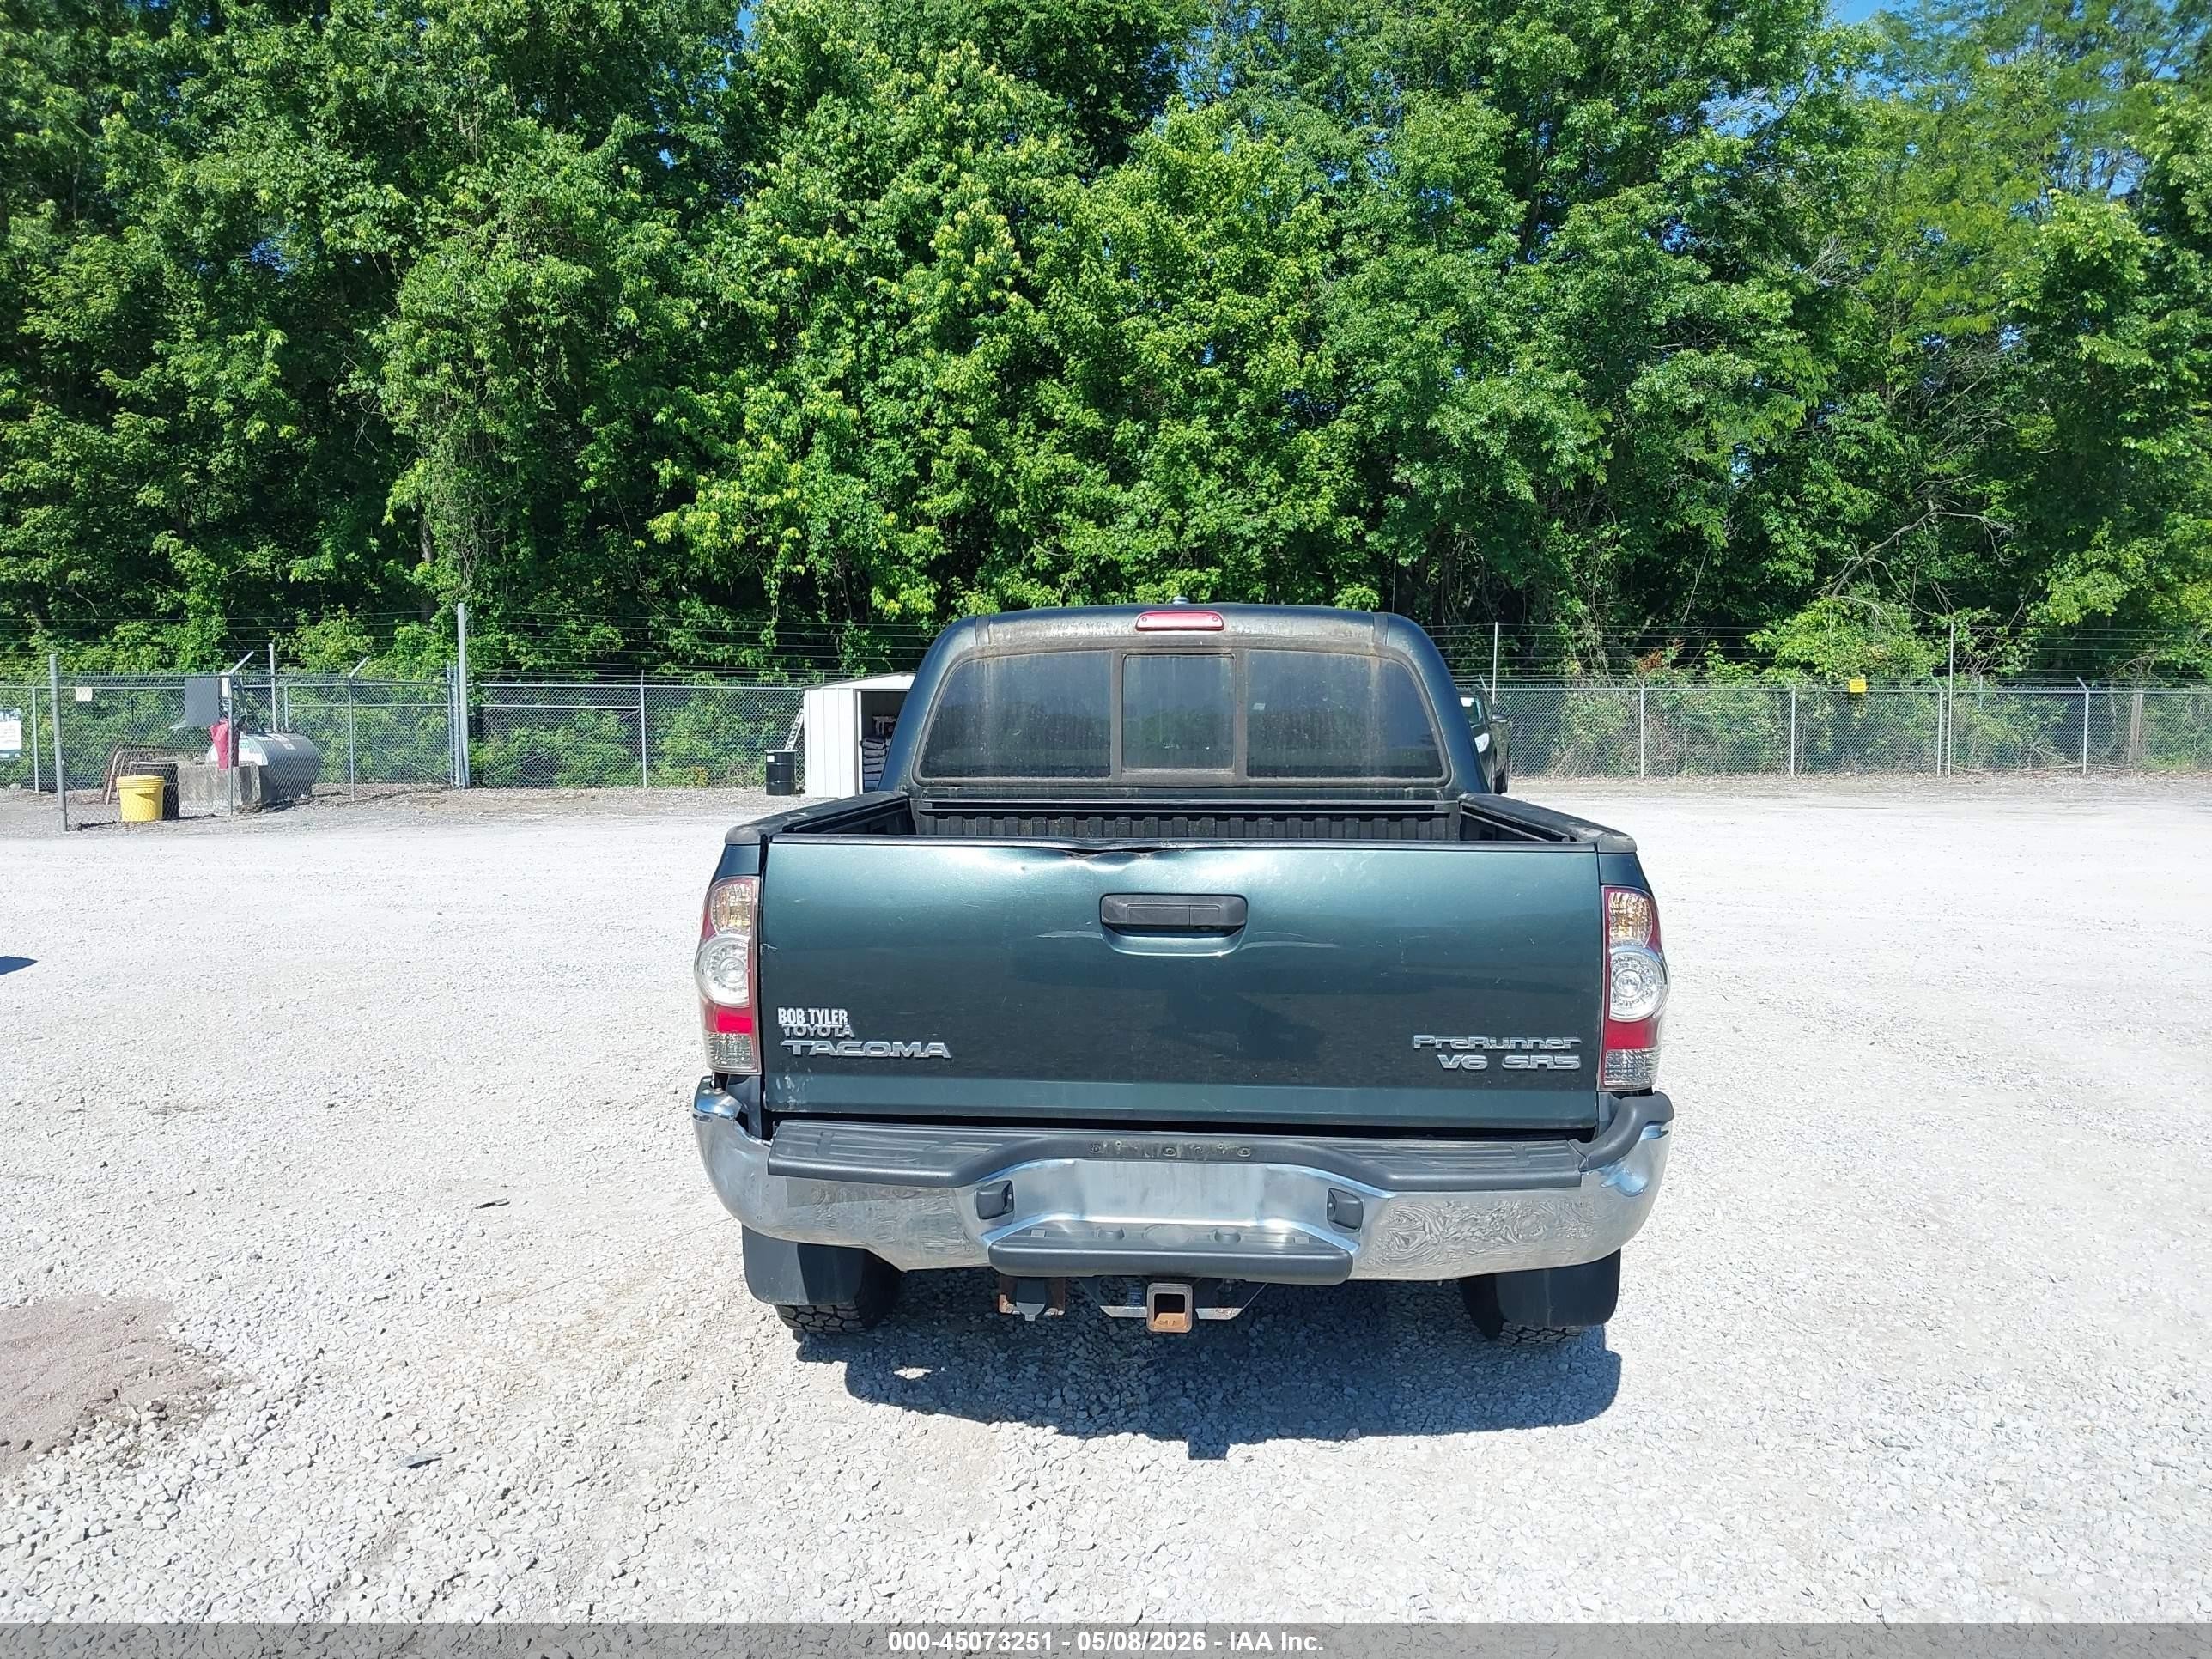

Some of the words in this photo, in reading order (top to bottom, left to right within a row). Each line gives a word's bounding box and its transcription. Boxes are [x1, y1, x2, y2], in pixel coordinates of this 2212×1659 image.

[778, 1007, 805, 1024] BOB
[808, 1007, 848, 1025] TYLER
[782, 1024, 855, 1038] TOYOTA
[780, 1040, 951, 1059] TACOMA
[1413, 1035, 1582, 1050] PreRunner
[1437, 1054, 1488, 1070] V6
[1503, 1054, 1581, 1070] SR5
